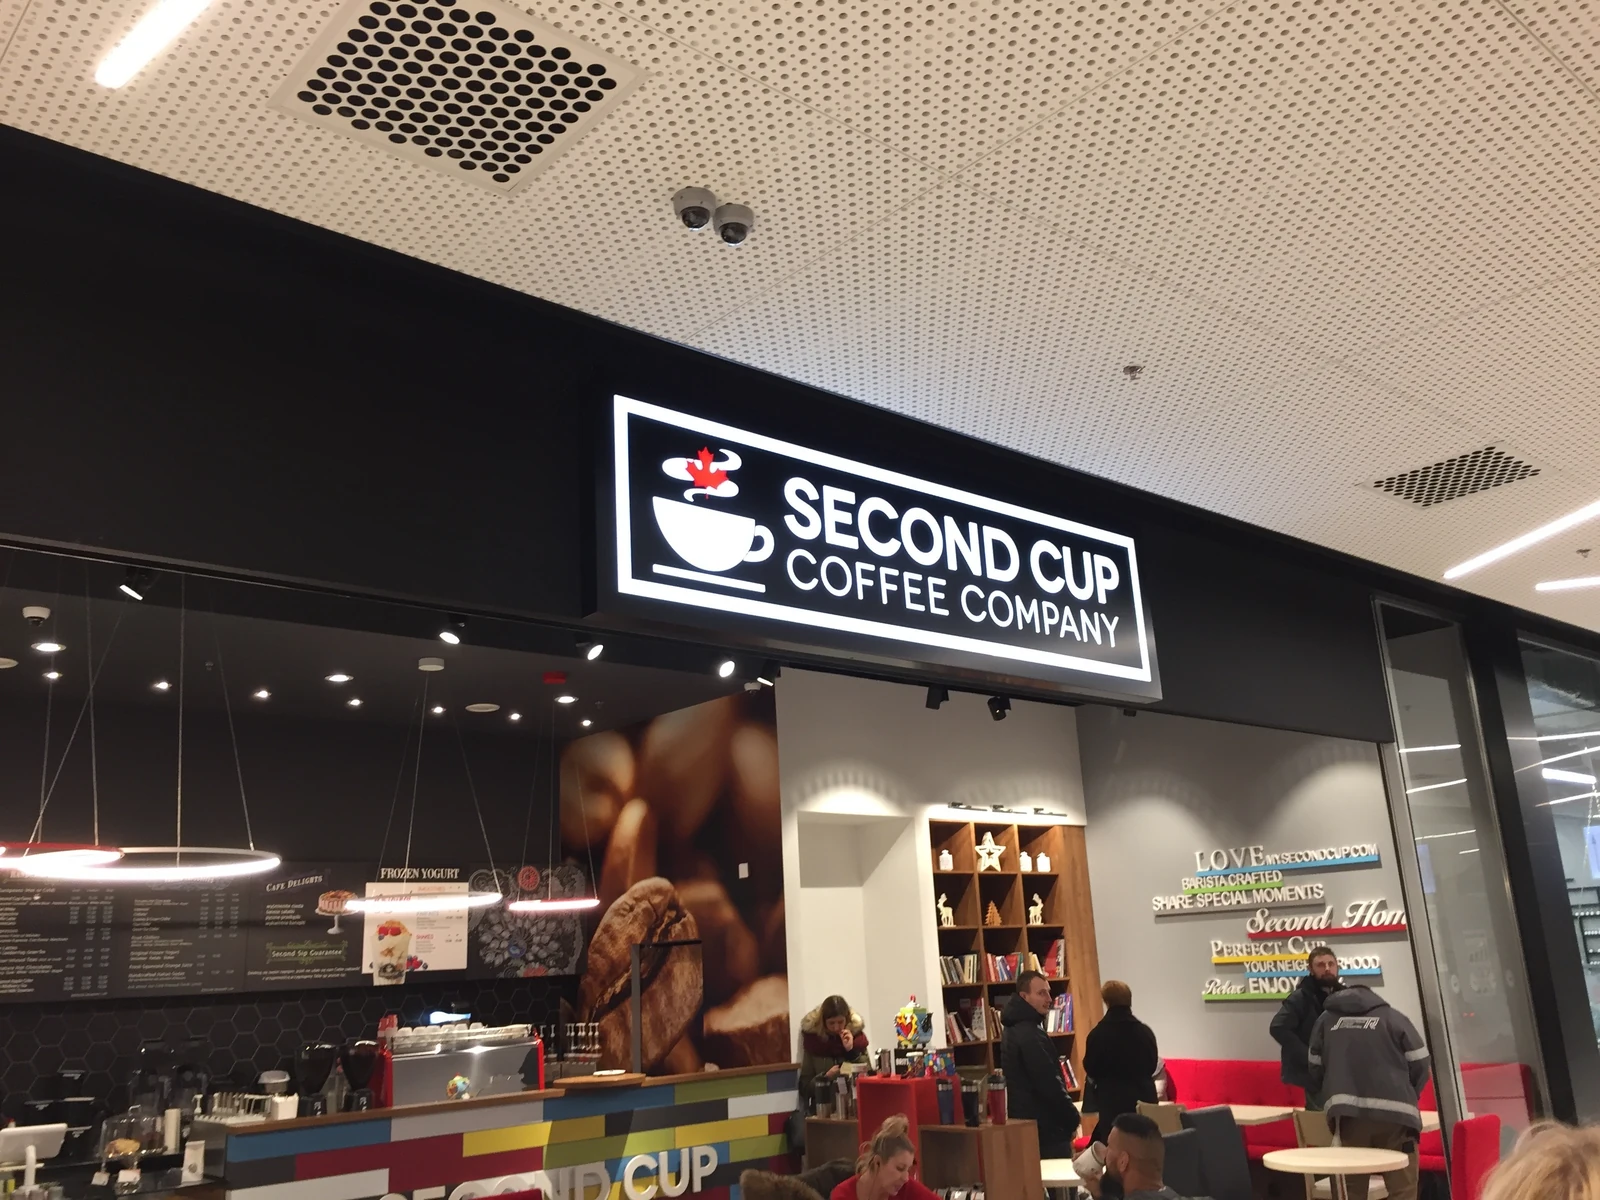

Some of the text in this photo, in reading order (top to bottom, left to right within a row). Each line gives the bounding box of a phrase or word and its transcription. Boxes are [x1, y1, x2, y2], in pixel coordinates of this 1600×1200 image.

[783, 476, 1120, 605] SECOND CUP
[786, 548, 1119, 648] COFFEE COMPANY
[1194, 845, 1266, 872] LOVE
[380, 867, 460, 880] FROZEN YOGURT
[1181, 869, 1283, 891] BARISTA CRAFTED
[1151, 883, 1325, 911] SHARE SPECIAL MOMENTS
[1246, 898, 1407, 934] Second Hom
[1211, 939, 1282, 958] PERFECT
[1243, 960, 1276, 974] YOUR
[1249, 976, 1299, 994] ENJOY
[623, 1145, 718, 1200] CUP
